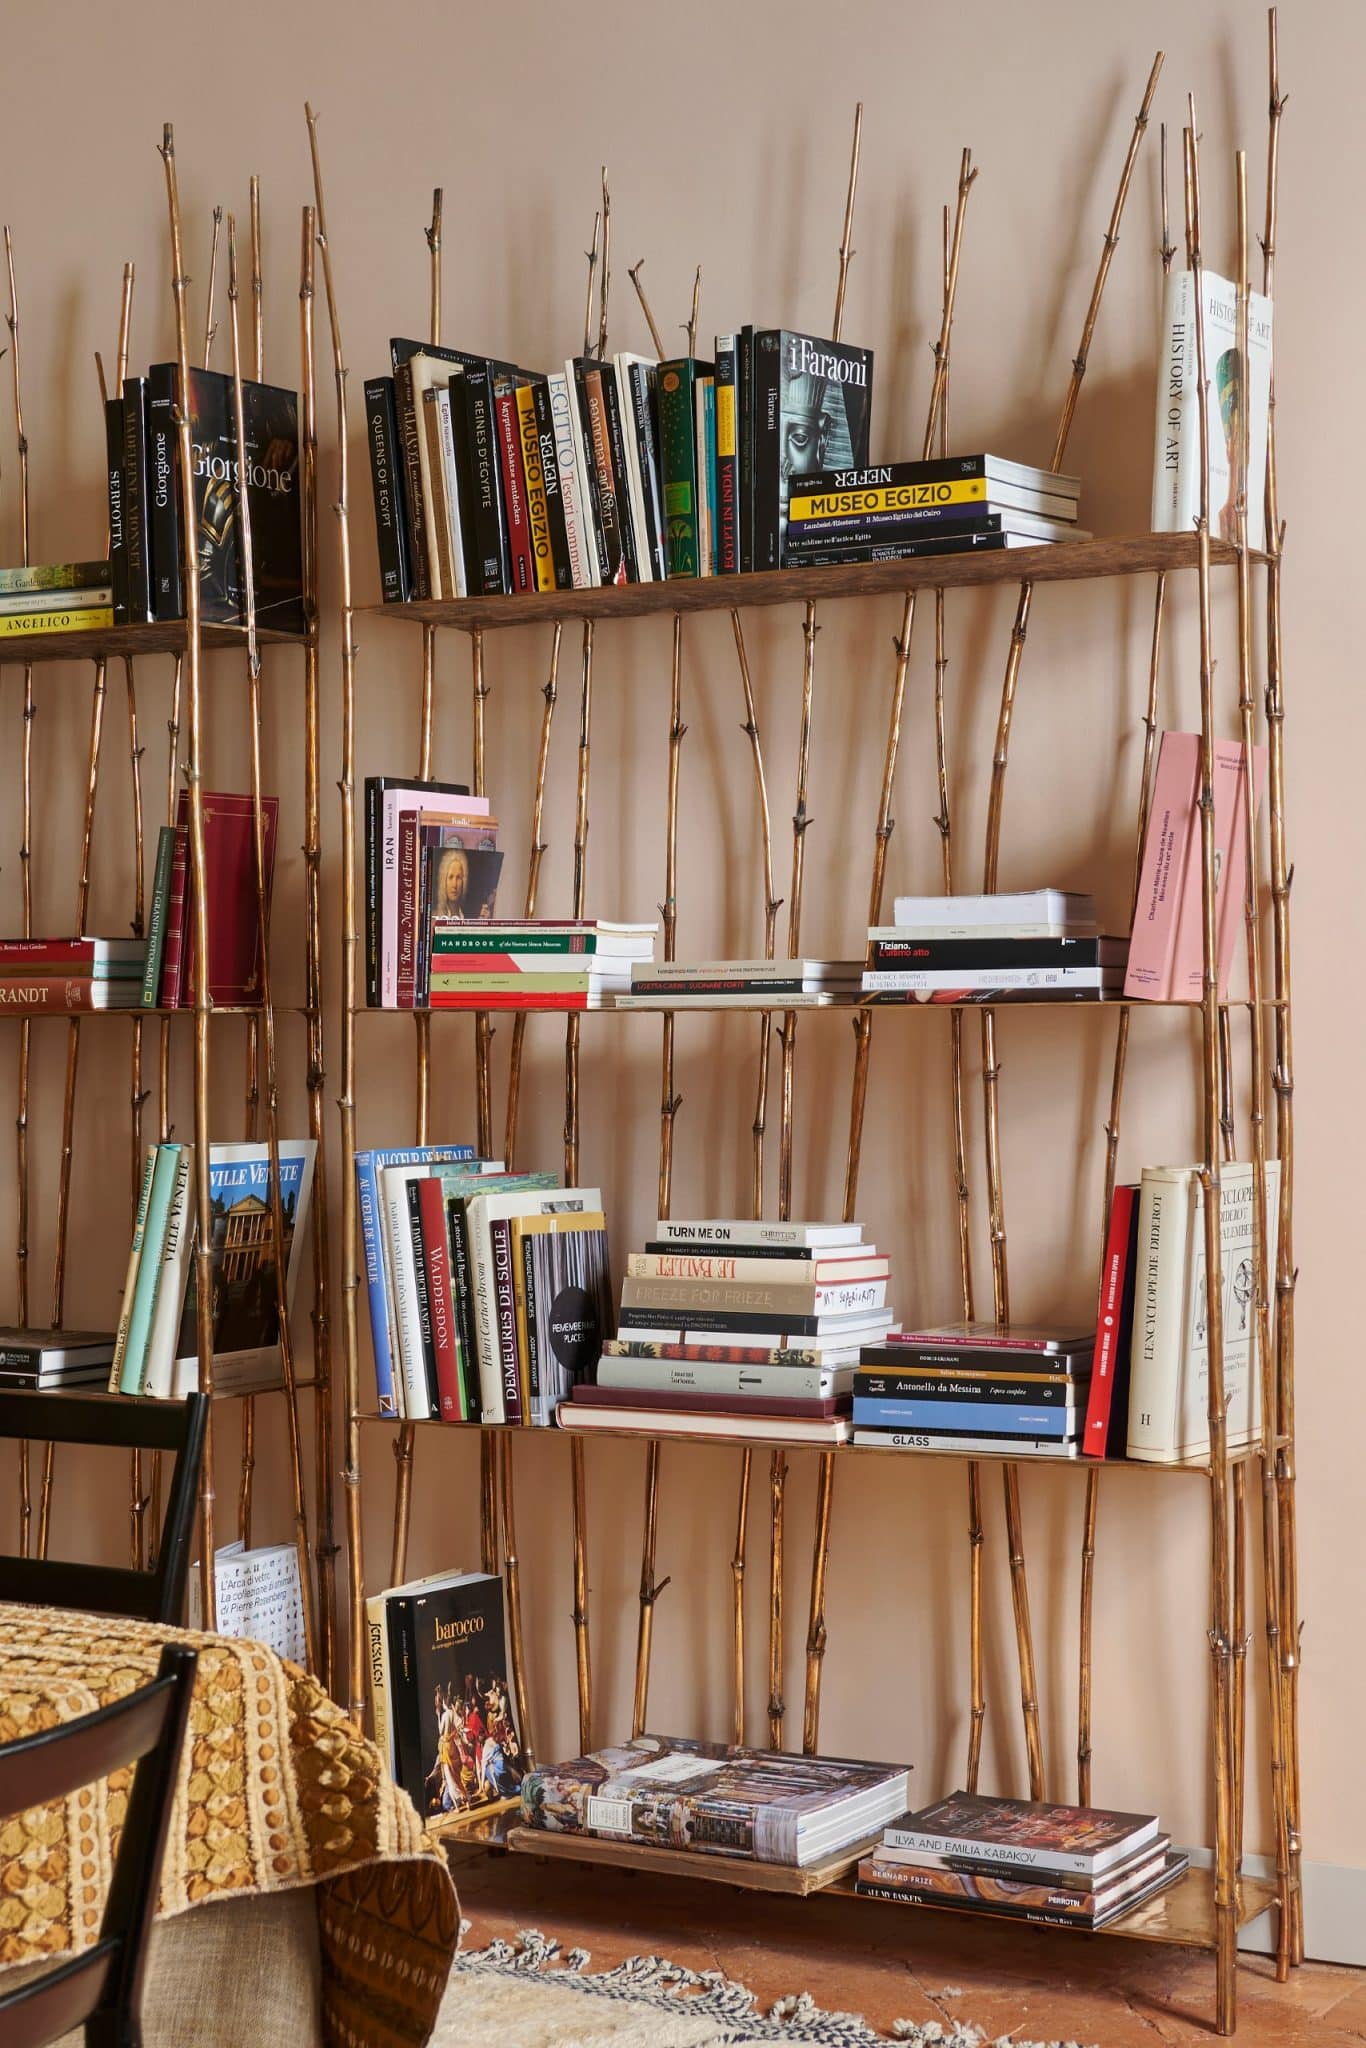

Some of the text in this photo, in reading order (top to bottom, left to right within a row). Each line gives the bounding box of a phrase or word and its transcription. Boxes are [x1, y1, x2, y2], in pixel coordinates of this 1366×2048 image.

[1255, 321, 1270, 341] ART
[790, 338, 867, 387] i Faraoni
[767, 392, 778, 430] Faraoni
[1165, 323, 1185, 473] HISTORY OF ART
[155, 432, 170, 508] Giorgione
[192, 444, 292, 493] Giorgione
[474, 400, 491, 508] REINES D'ÉGYPTE
[539, 432, 558, 496] NEFER
[371, 414, 391, 528] QUEENS OF EGYPT
[521, 408, 549, 559] MUSEO EGIZIO
[551, 380, 586, 589] EGITTO Tesori sommersi
[835, 467, 892, 488] NEFER
[125, 411, 141, 569] MADELEINE VIONNET
[511, 479, 520, 525] entdecken
[811, 484, 952, 515] MUSEO EGIZIO
[110, 470, 124, 549] SERPOTTA
[723, 463, 735, 568] EGYPT IN INDIA
[872, 515, 892, 523] Museo
[7, 616, 70, 630] ANGELICO
[385, 836, 395, 870] IRAN
[402, 830, 414, 876] Florence
[1152, 848, 1165, 887] Marie-Laure
[151, 897, 161, 932] GRANDI
[401, 890, 414, 927] Naples
[1149, 896, 1157, 920] Charles
[145, 935, 157, 987] FOTOGRAFI
[401, 931, 412, 964] Rome,
[879, 942, 911, 950] Tiziano.
[879, 949, 929, 957] L'ultimo atto
[209, 1163, 298, 1187] VILLE VETE
[376, 1152, 389, 1166] AU
[359, 1177, 369, 1192] AU
[165, 1160, 190, 1262] VILLE VENETE
[1149, 1194, 1163, 1252] DIDEROT
[365, 1228, 375, 1241] DE
[412, 1228, 424, 1255] DAVID
[667, 1226, 730, 1239] TURN ME ON
[366, 1243, 378, 1284] L'ITALIE
[453, 1213, 466, 1297] La storia del Bargello
[525, 1241, 534, 1290] REMEMBERING
[656, 1256, 736, 1279] LE BALLET
[417, 1268, 431, 1343] MICHELANGELO
[430, 1246, 449, 1349] WADDESDON
[527, 1293, 535, 1318] PLACES
[636, 1288, 774, 1306] FREEZE FOR FRIEZE
[495, 1229, 518, 1400] DEMEURES DE SICILE
[553, 1321, 595, 1343] REMEMBERING PLACES
[481, 1337, 493, 1366] Henri
[896, 1381, 936, 1392] Antonello
[937, 1383, 947, 1392] da
[949, 1384, 982, 1394] Messina
[892, 1435, 930, 1447] GLASS
[220, 1593, 231, 1603] La
[221, 1578, 245, 1590] L'Arca
[220, 1606, 229, 1615] di
[231, 1601, 254, 1613] Pierre
[435, 1616, 484, 1641] barocco
[895, 1835, 1036, 1864] ILYA AND EMILIA KABAKOV
[872, 1870, 933, 1886] BERNARD FRIZE
[881, 1890, 892, 1898] MY
[893, 1892, 923, 1903] BASKETS
[1048, 1896, 1080, 1907] PERROTIN
